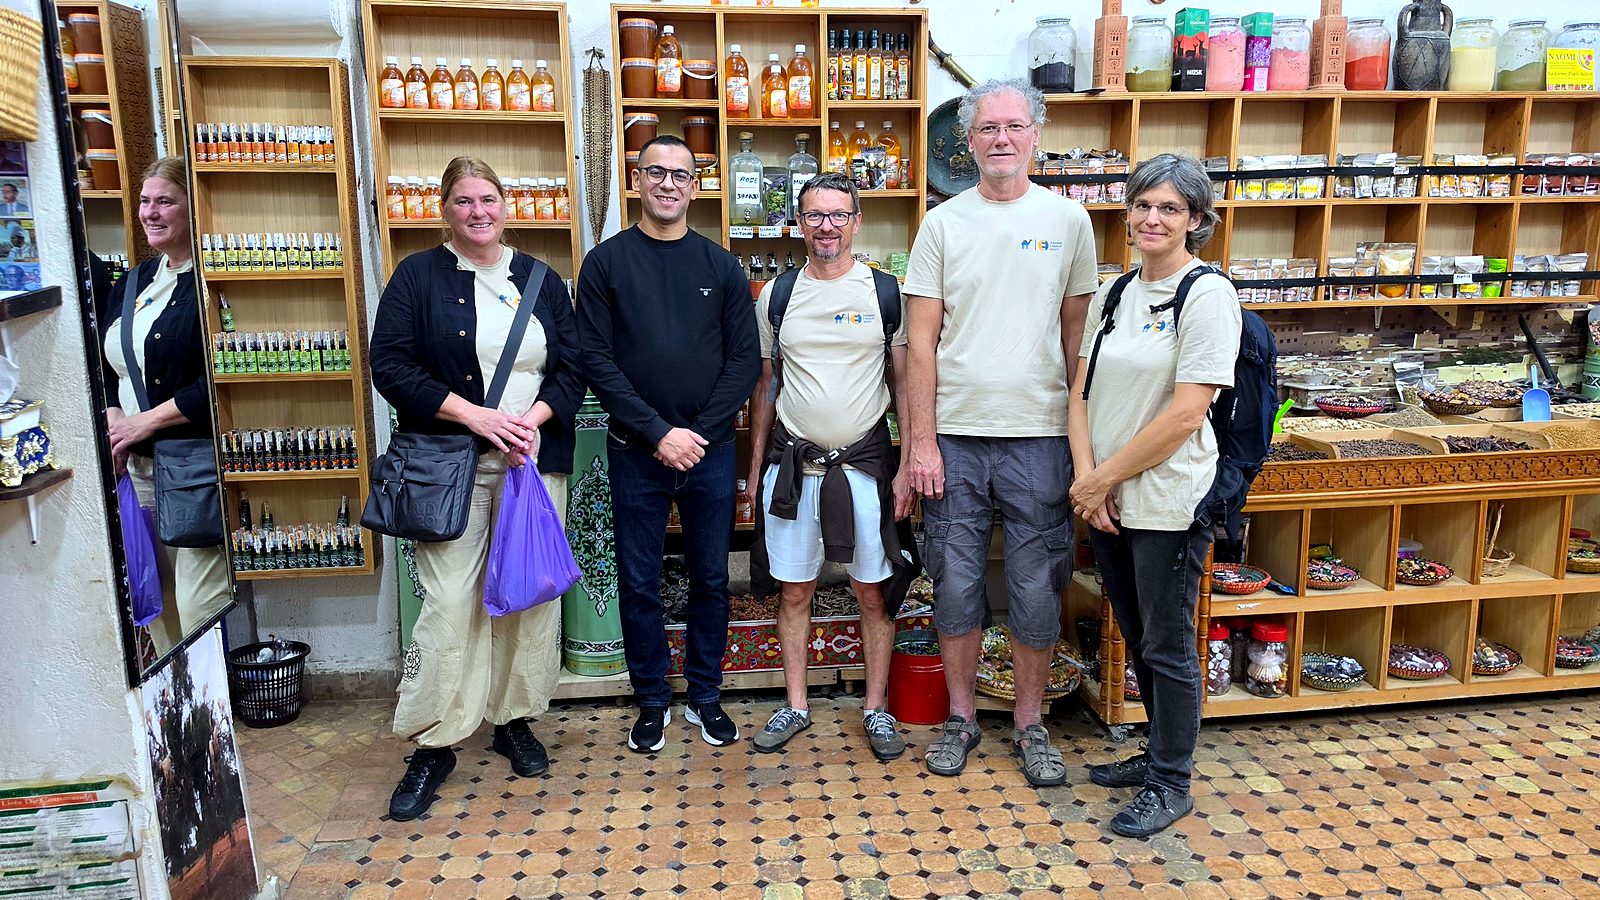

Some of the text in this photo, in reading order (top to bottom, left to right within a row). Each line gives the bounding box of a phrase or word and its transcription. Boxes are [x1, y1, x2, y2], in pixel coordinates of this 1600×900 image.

[1548, 53, 1576, 61] NAOMI
[25, 798, 37, 806] De
[39, 793, 94, 805] Commande
